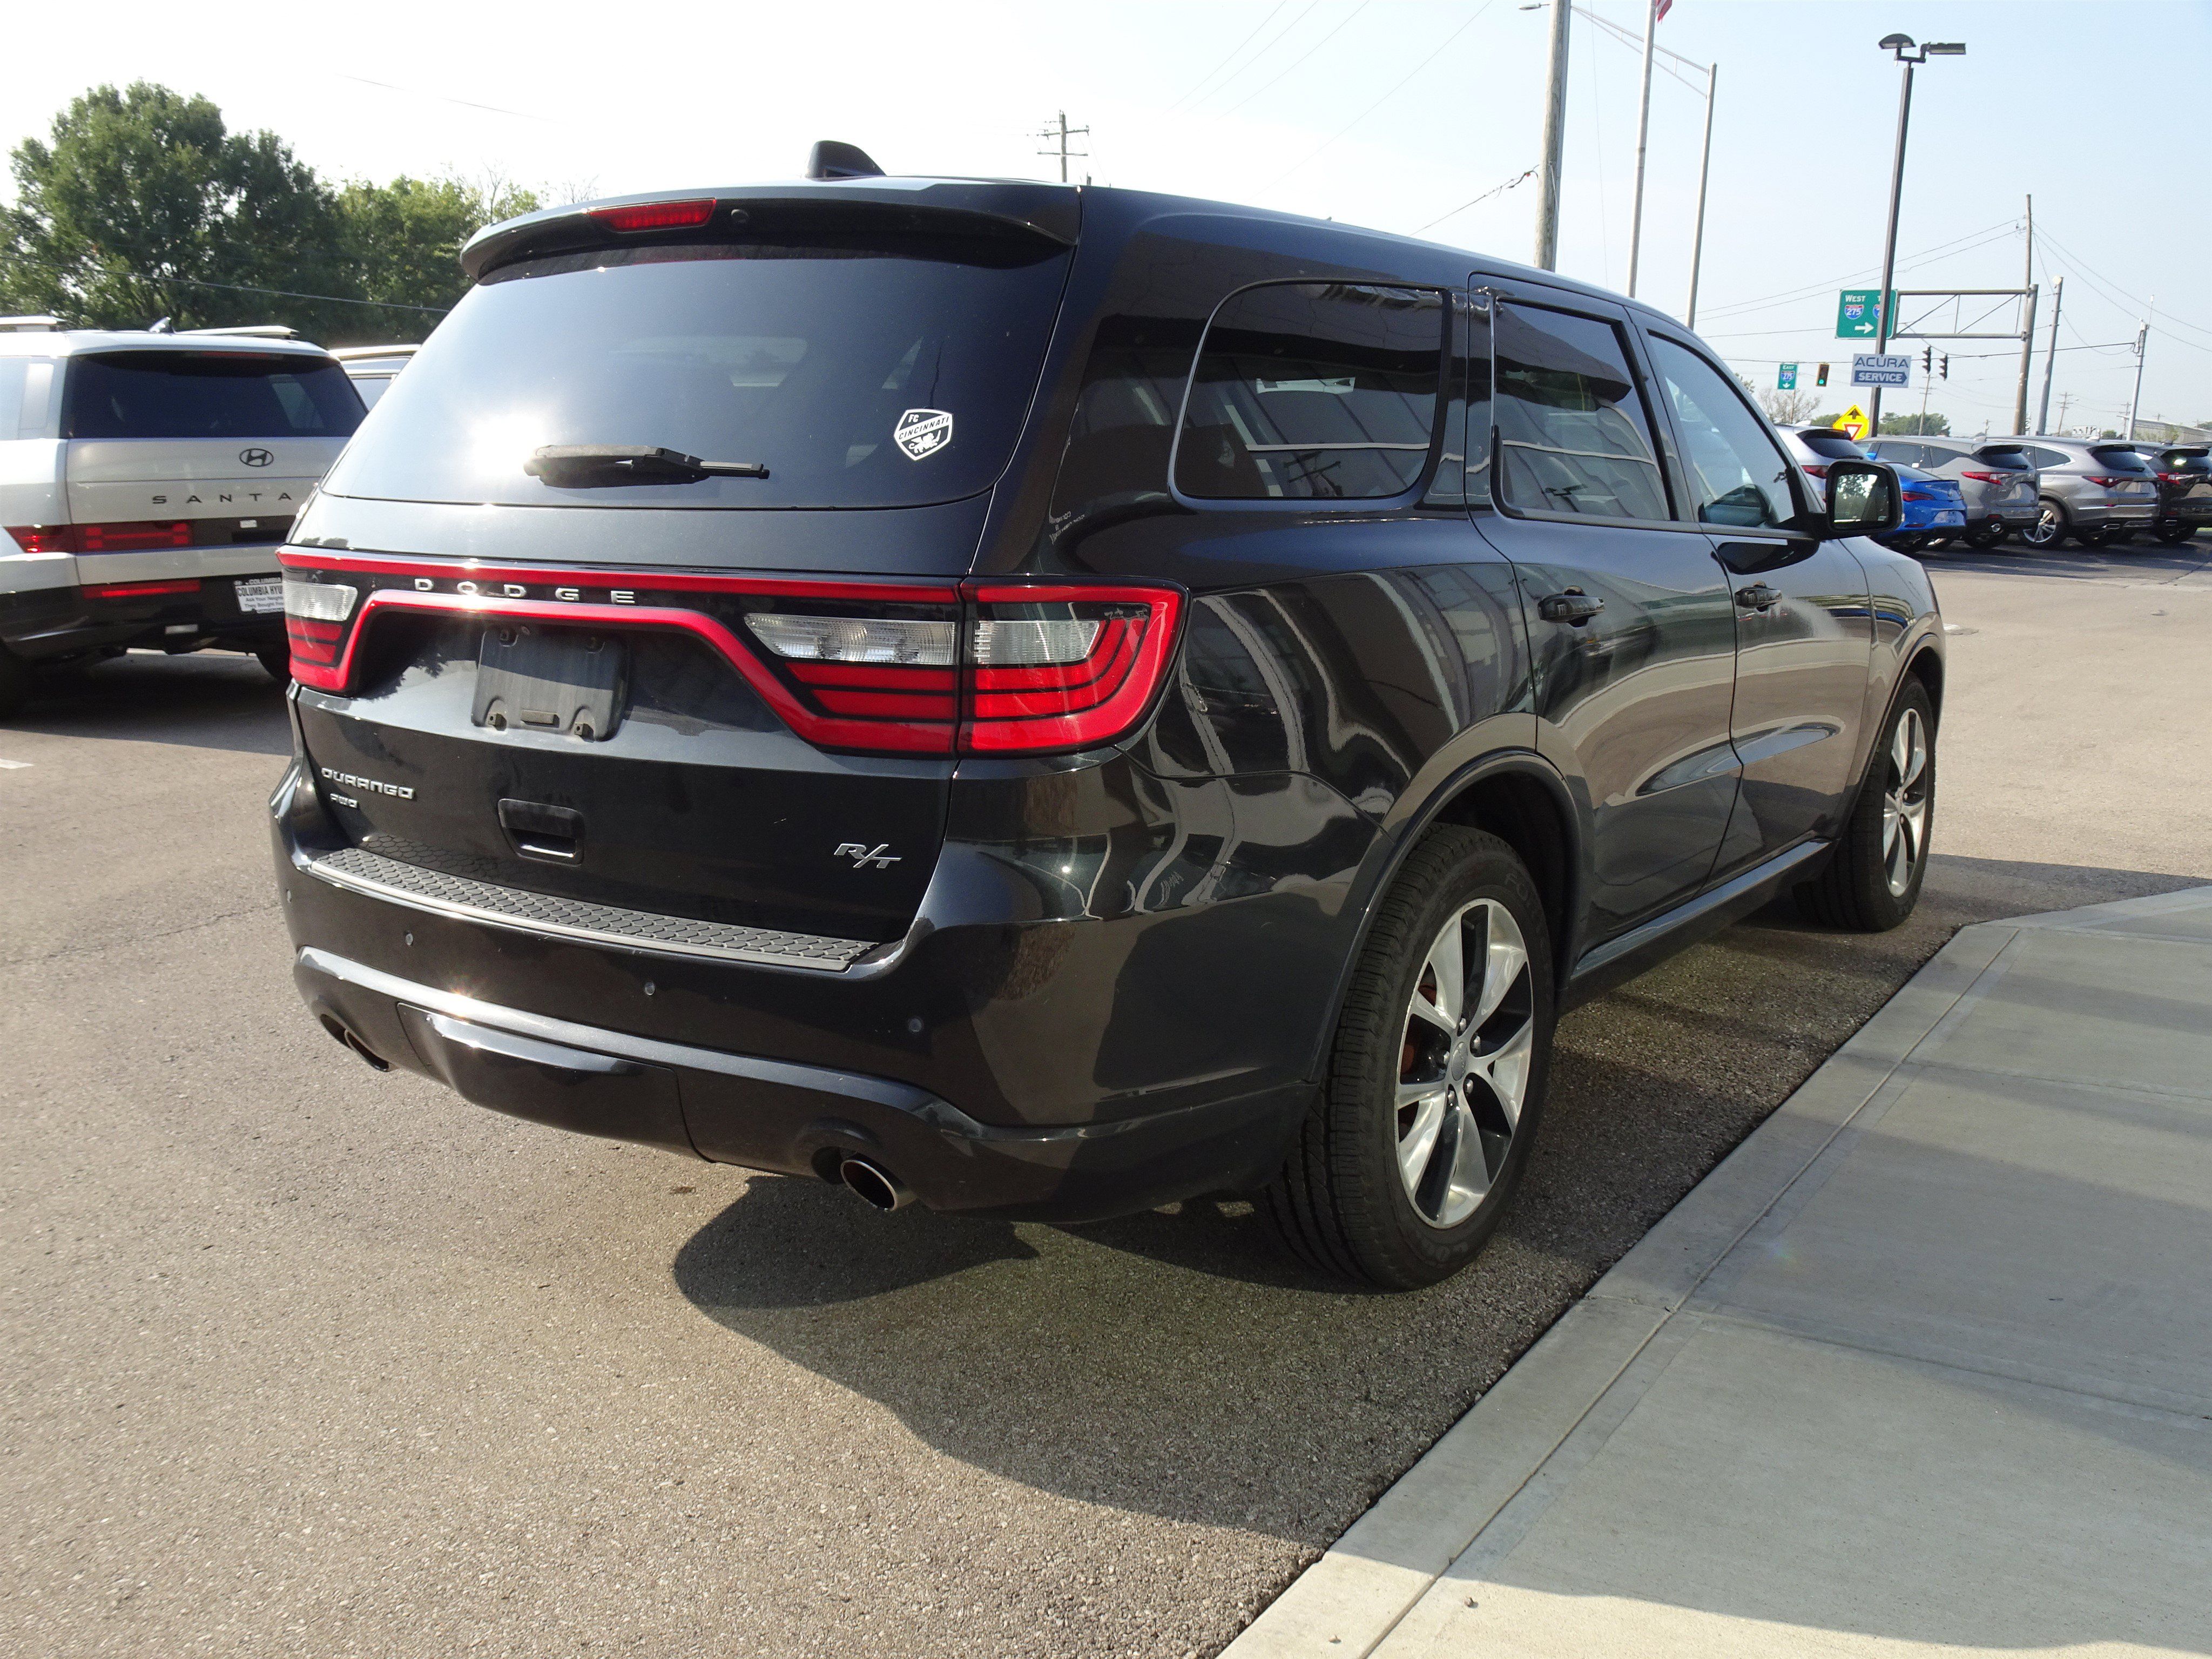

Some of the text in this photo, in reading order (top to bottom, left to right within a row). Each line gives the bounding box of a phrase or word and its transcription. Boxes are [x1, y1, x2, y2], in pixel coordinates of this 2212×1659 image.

[1854, 357, 1908, 368] ACURA
[1858, 372, 1903, 382] SERVICE
[908, 414, 919, 423] FC
[899, 416, 949, 440] CINCINNATI
[152, 493, 292, 504] SANTA
[237, 586, 269, 596] COLUMBIA
[414, 578, 635, 604] DODGE
[321, 767, 414, 800] DURANGO
[330, 793, 358, 808] AWD
[834, 843, 902, 868] R/T
